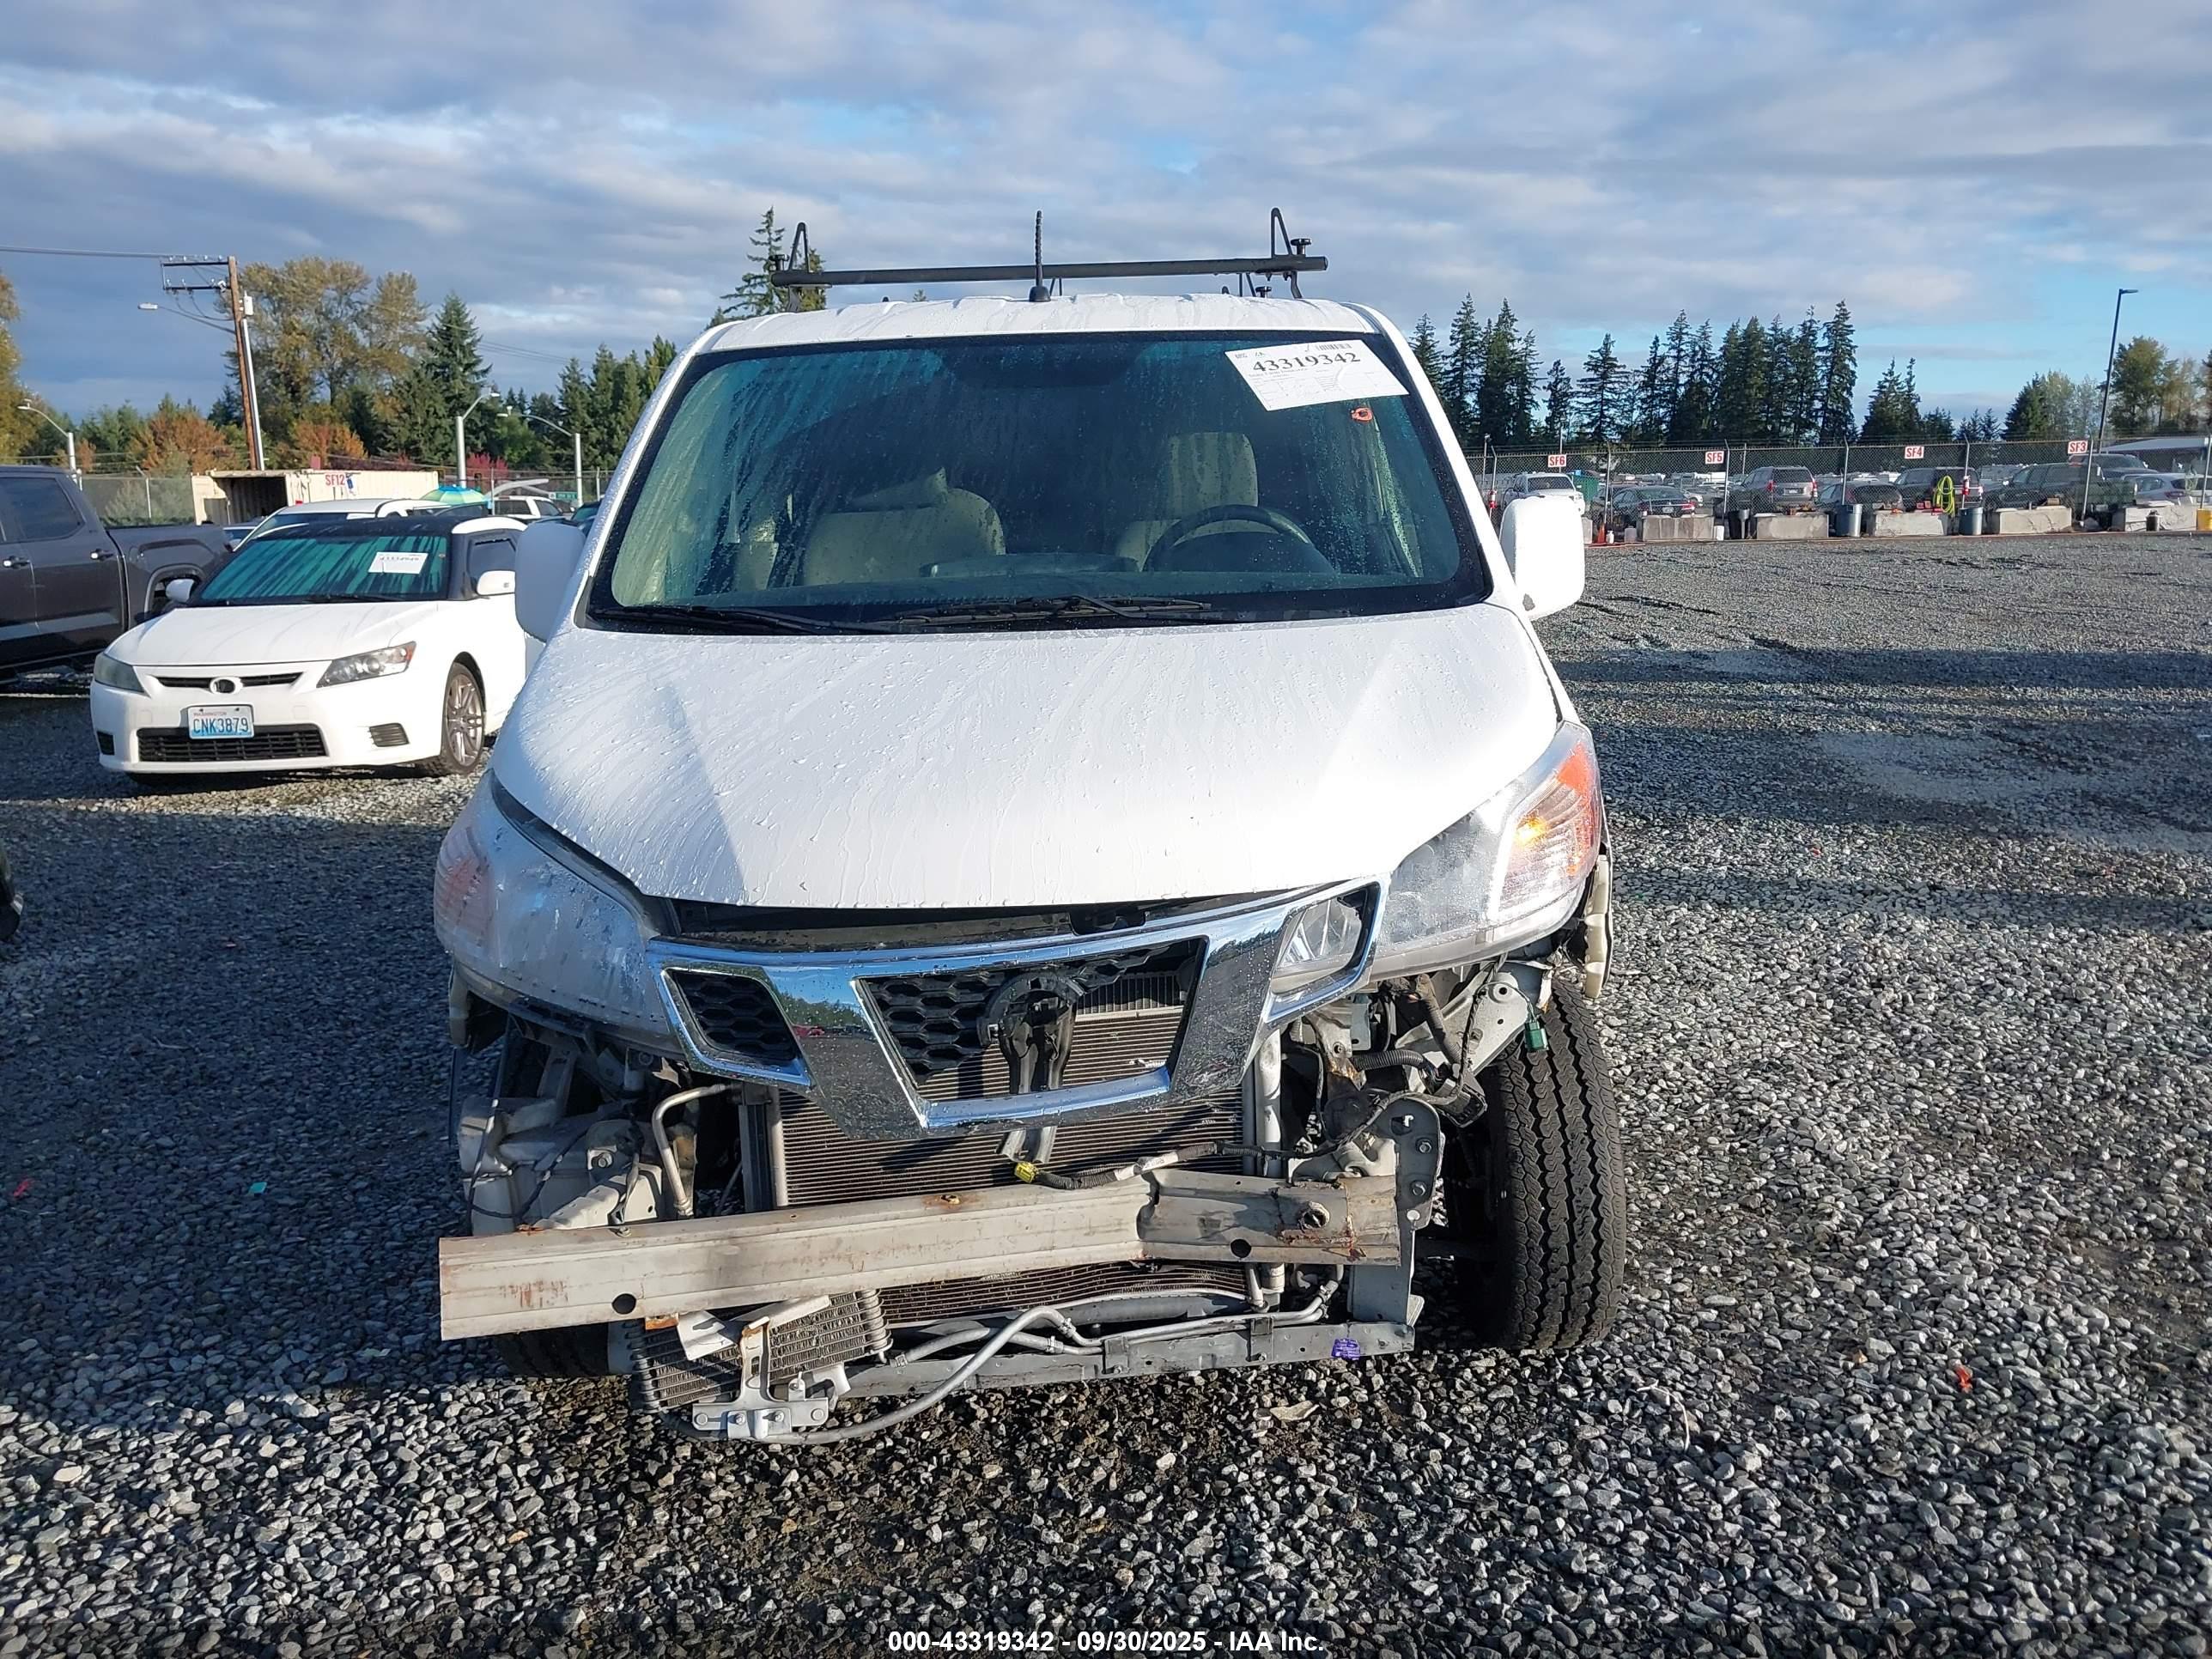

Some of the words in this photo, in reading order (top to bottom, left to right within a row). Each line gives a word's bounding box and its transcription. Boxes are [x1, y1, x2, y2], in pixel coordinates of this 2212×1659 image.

[1253, 352, 1360, 372] 43319342
[1906, 447, 1922, 457] SF4
[2069, 441, 2087, 452] SF3
[1549, 455, 1565, 466] SF6
[1707, 452, 1723, 462] SF5
[325, 474, 345, 485] SF12
[193, 718, 249, 733] CNK3879
